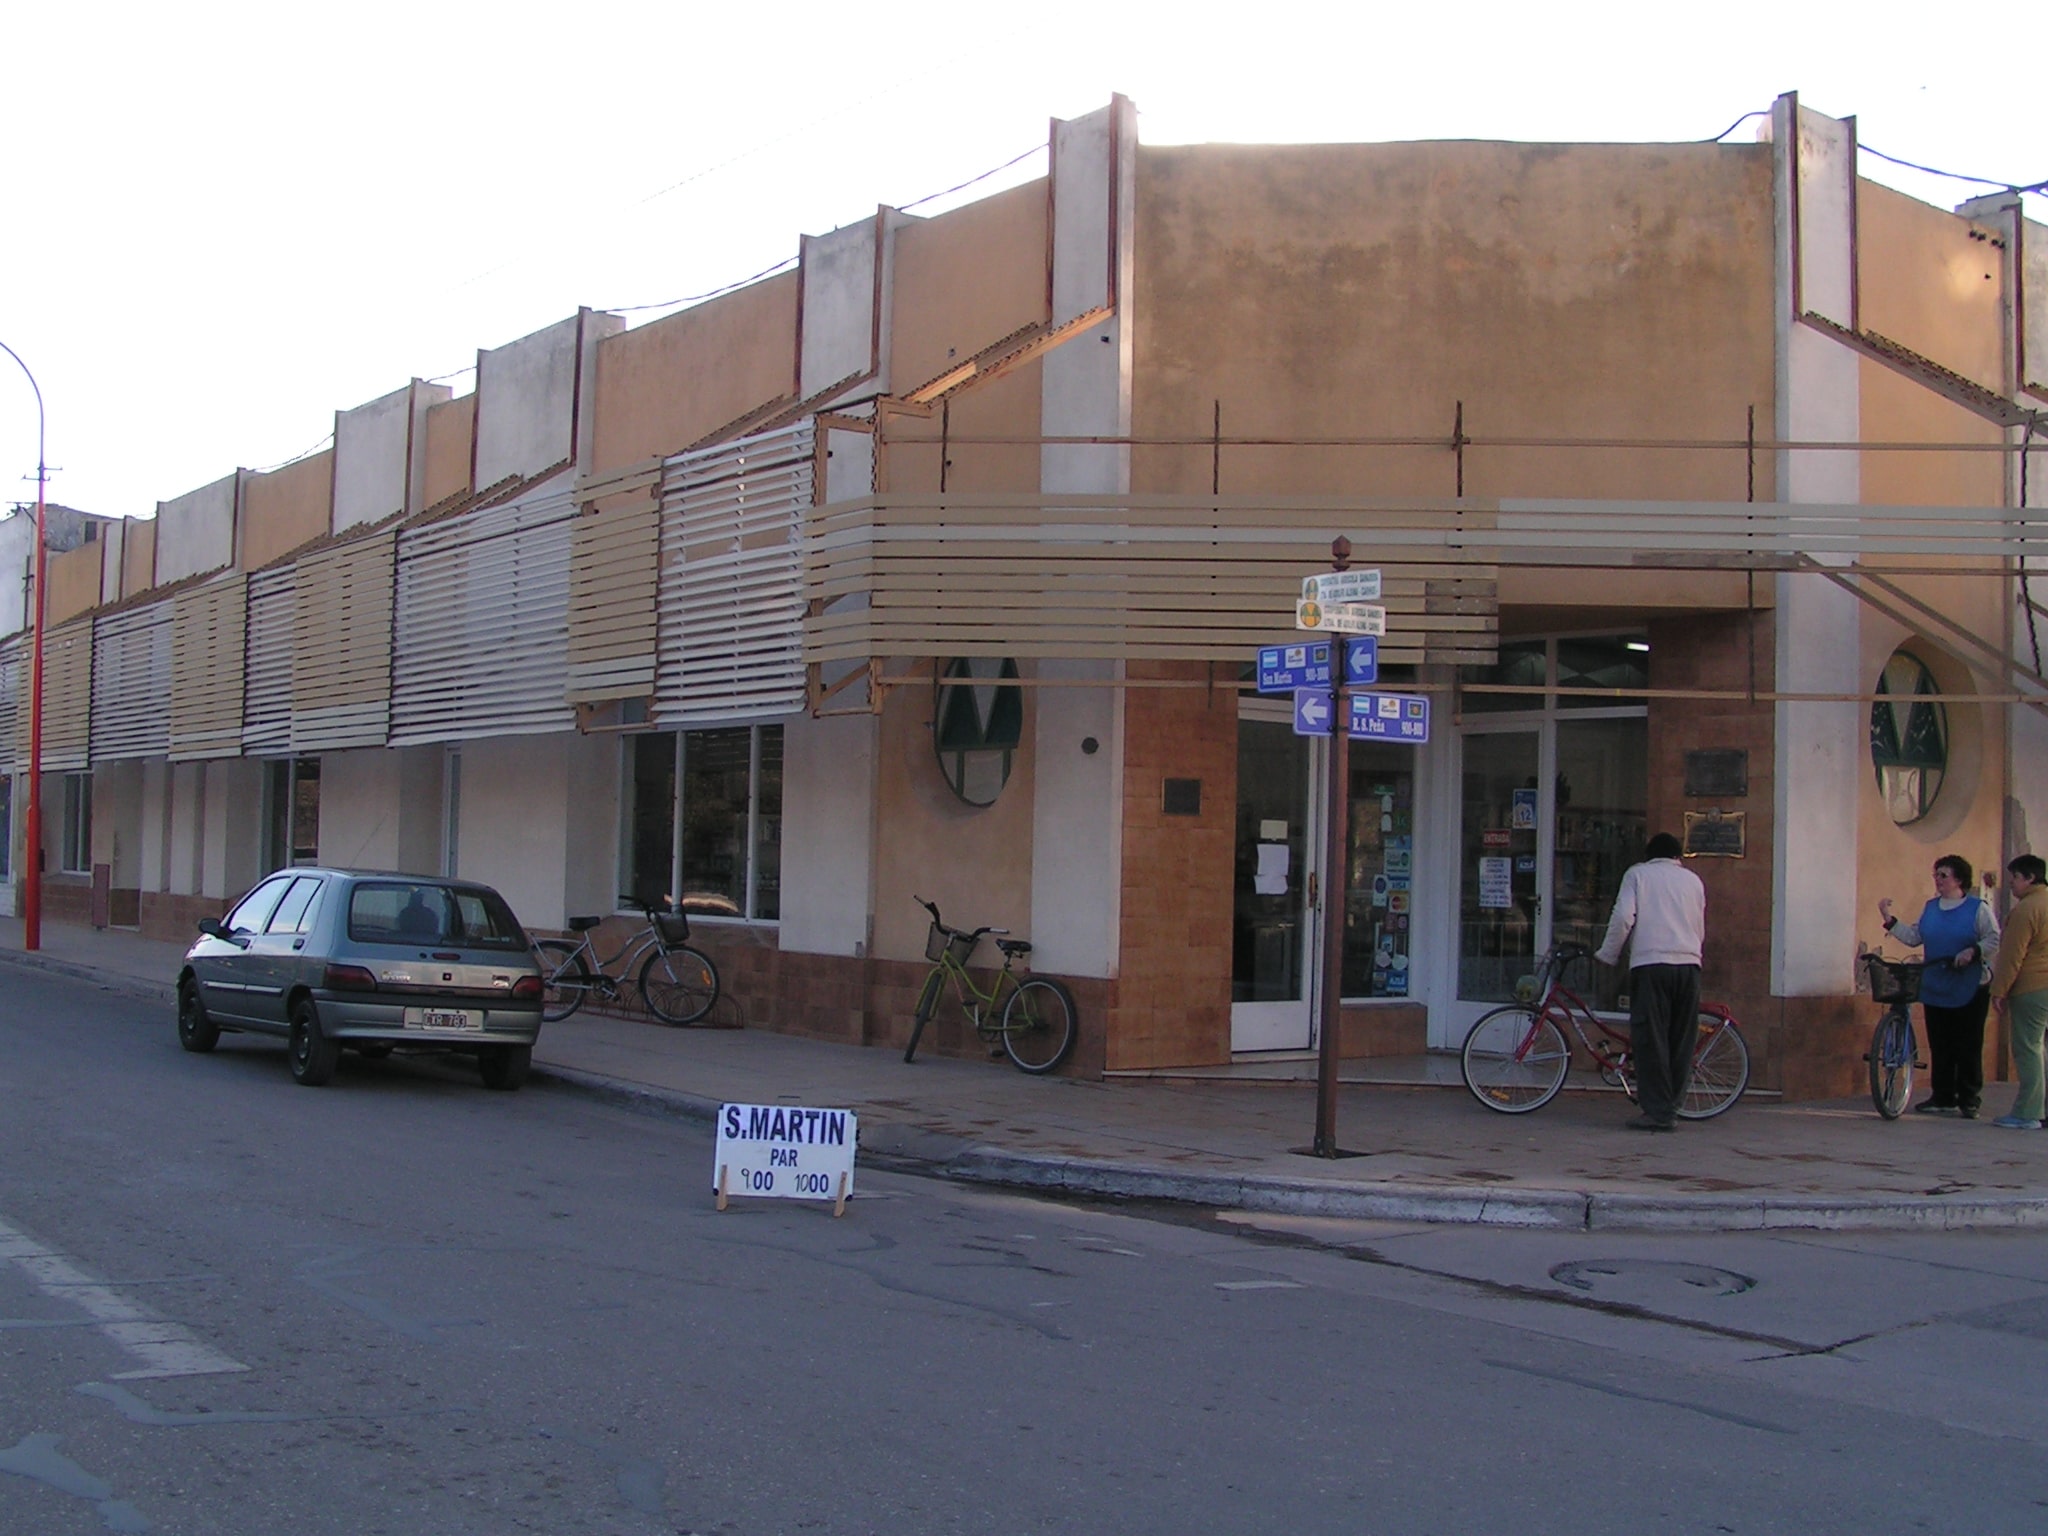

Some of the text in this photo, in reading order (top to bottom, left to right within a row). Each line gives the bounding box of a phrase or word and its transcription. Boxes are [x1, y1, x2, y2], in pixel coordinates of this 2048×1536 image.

[725, 1105, 846, 1146] S.MARTIN
[770, 1148, 798, 1167] PAR
[794, 1173, 829, 1193] 1000
